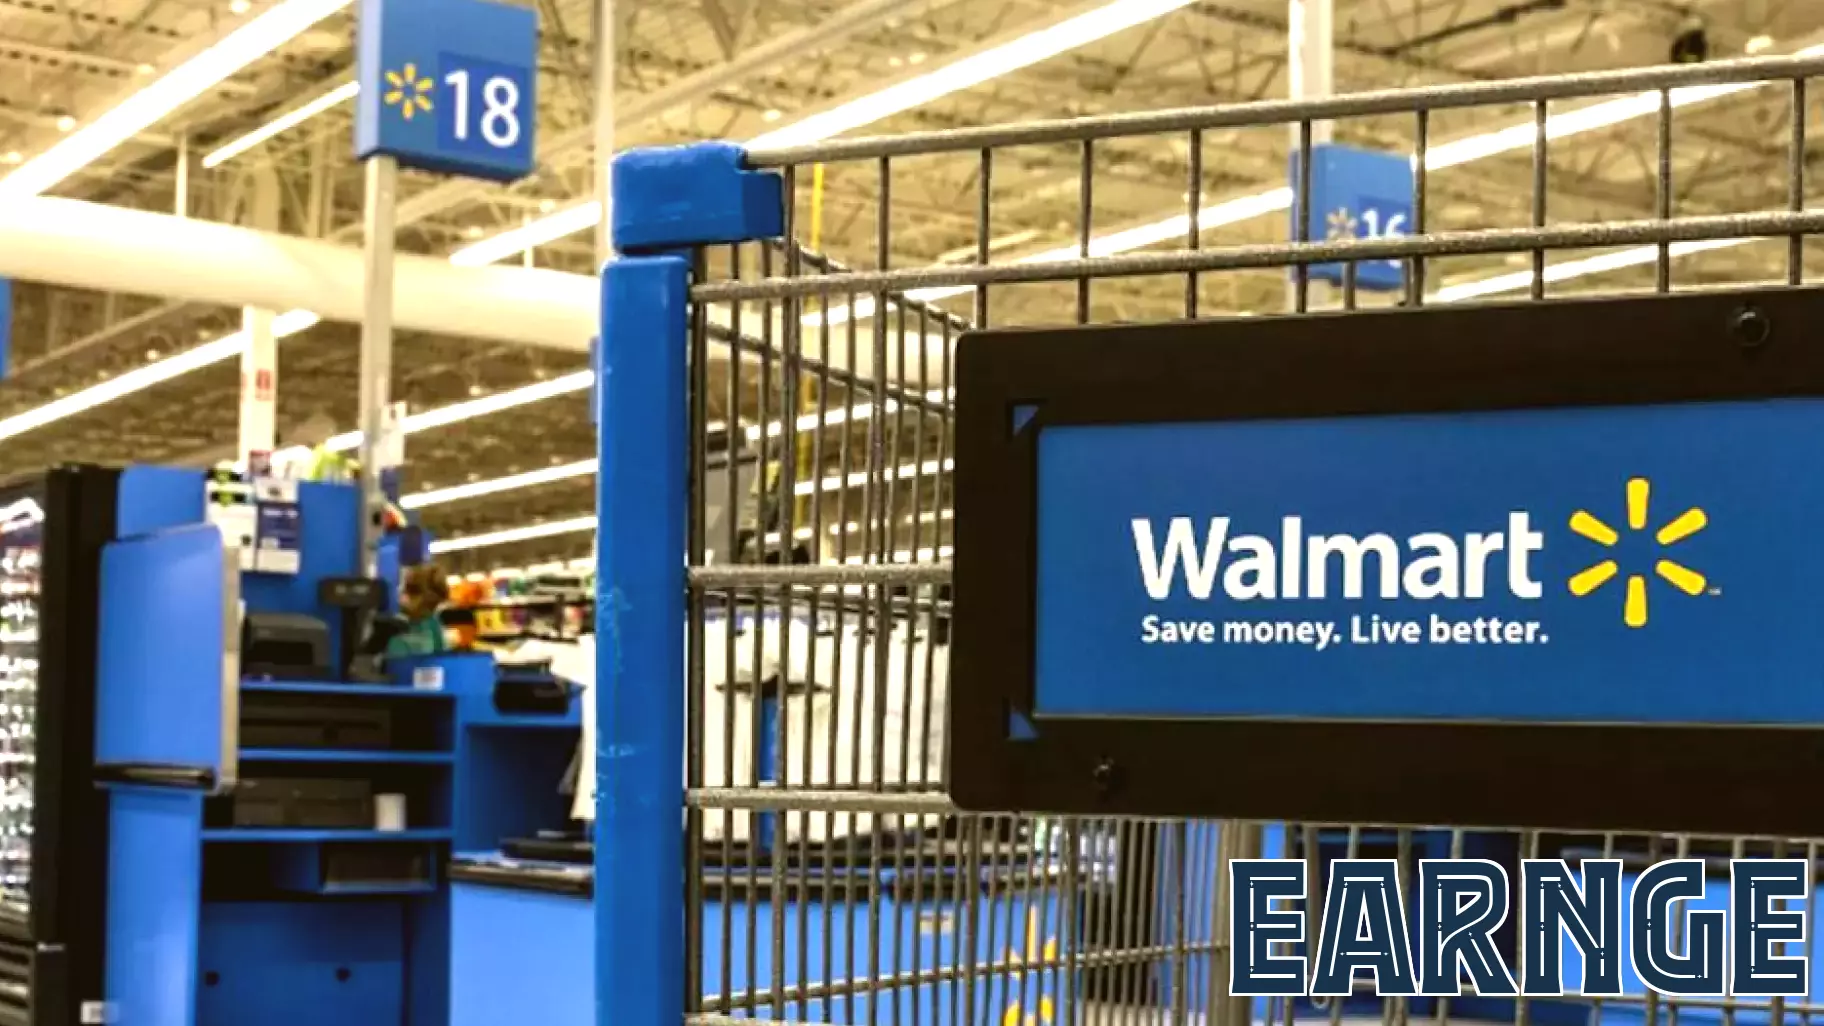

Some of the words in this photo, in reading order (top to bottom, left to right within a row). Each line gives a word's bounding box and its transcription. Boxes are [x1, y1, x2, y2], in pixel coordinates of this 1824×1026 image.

[444, 69, 521, 148] 18
[1131, 511, 1544, 600] Walmart
[1141, 615, 1215, 644] Save
[1223, 616, 1341, 650] money.
[1351, 615, 1421, 643] Live
[1429, 614, 1549, 643] better.
